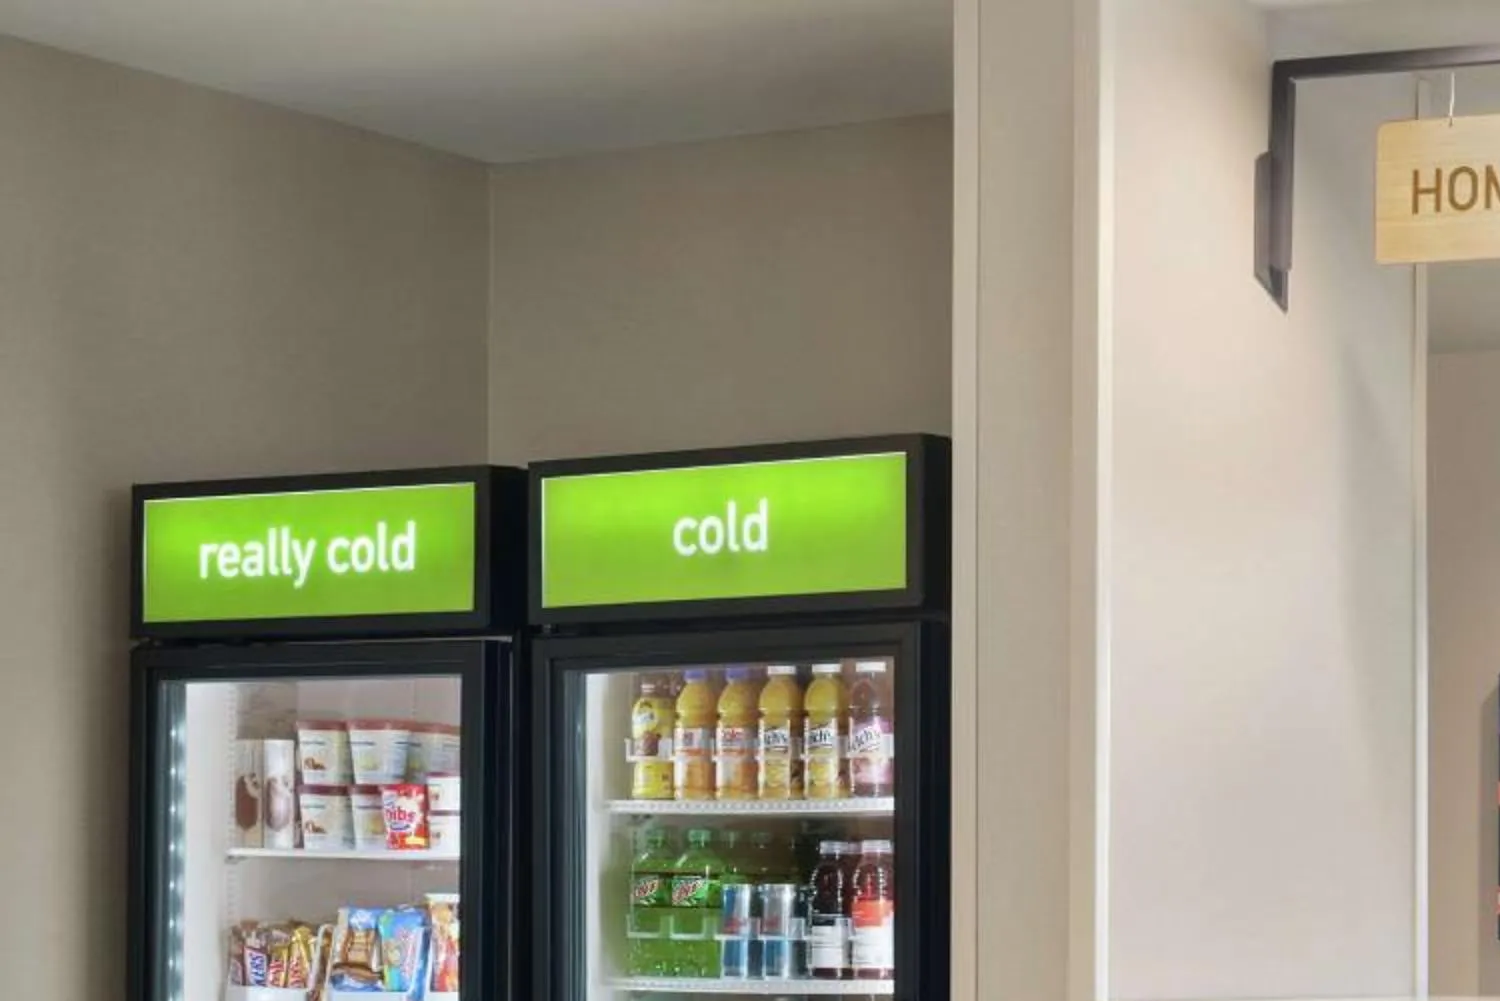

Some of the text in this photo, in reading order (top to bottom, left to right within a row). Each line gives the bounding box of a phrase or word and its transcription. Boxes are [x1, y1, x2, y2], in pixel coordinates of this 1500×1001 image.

[200, 522, 415, 585] really cold
[674, 500, 767, 555] cold
